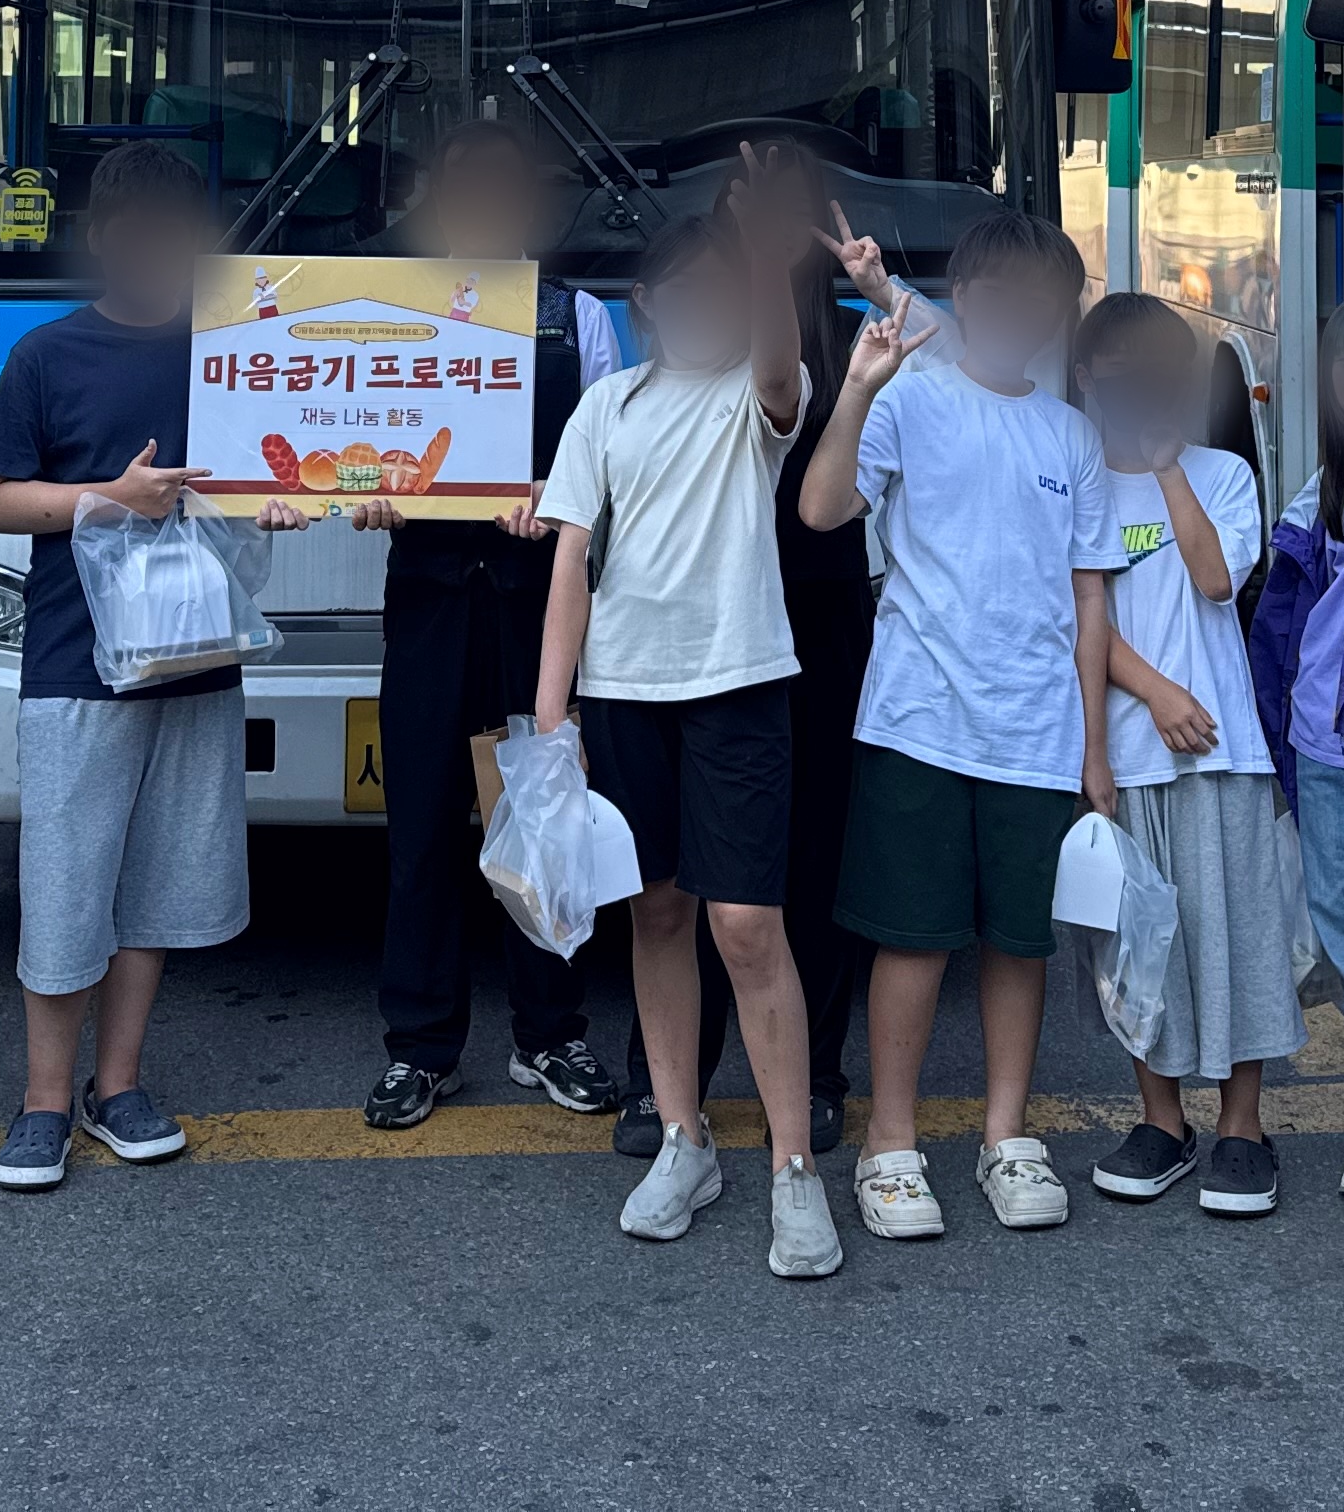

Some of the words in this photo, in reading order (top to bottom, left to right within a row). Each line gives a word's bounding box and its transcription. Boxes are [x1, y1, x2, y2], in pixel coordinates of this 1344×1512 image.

[203, 352, 356, 393] 마음굽기
[365, 354, 522, 394] 프로젝트
[299, 407, 338, 426] 재능
[343, 407, 381, 427] 나눔
[386, 407, 424, 427] 활동
[1038, 474, 1069, 496] UCLA
